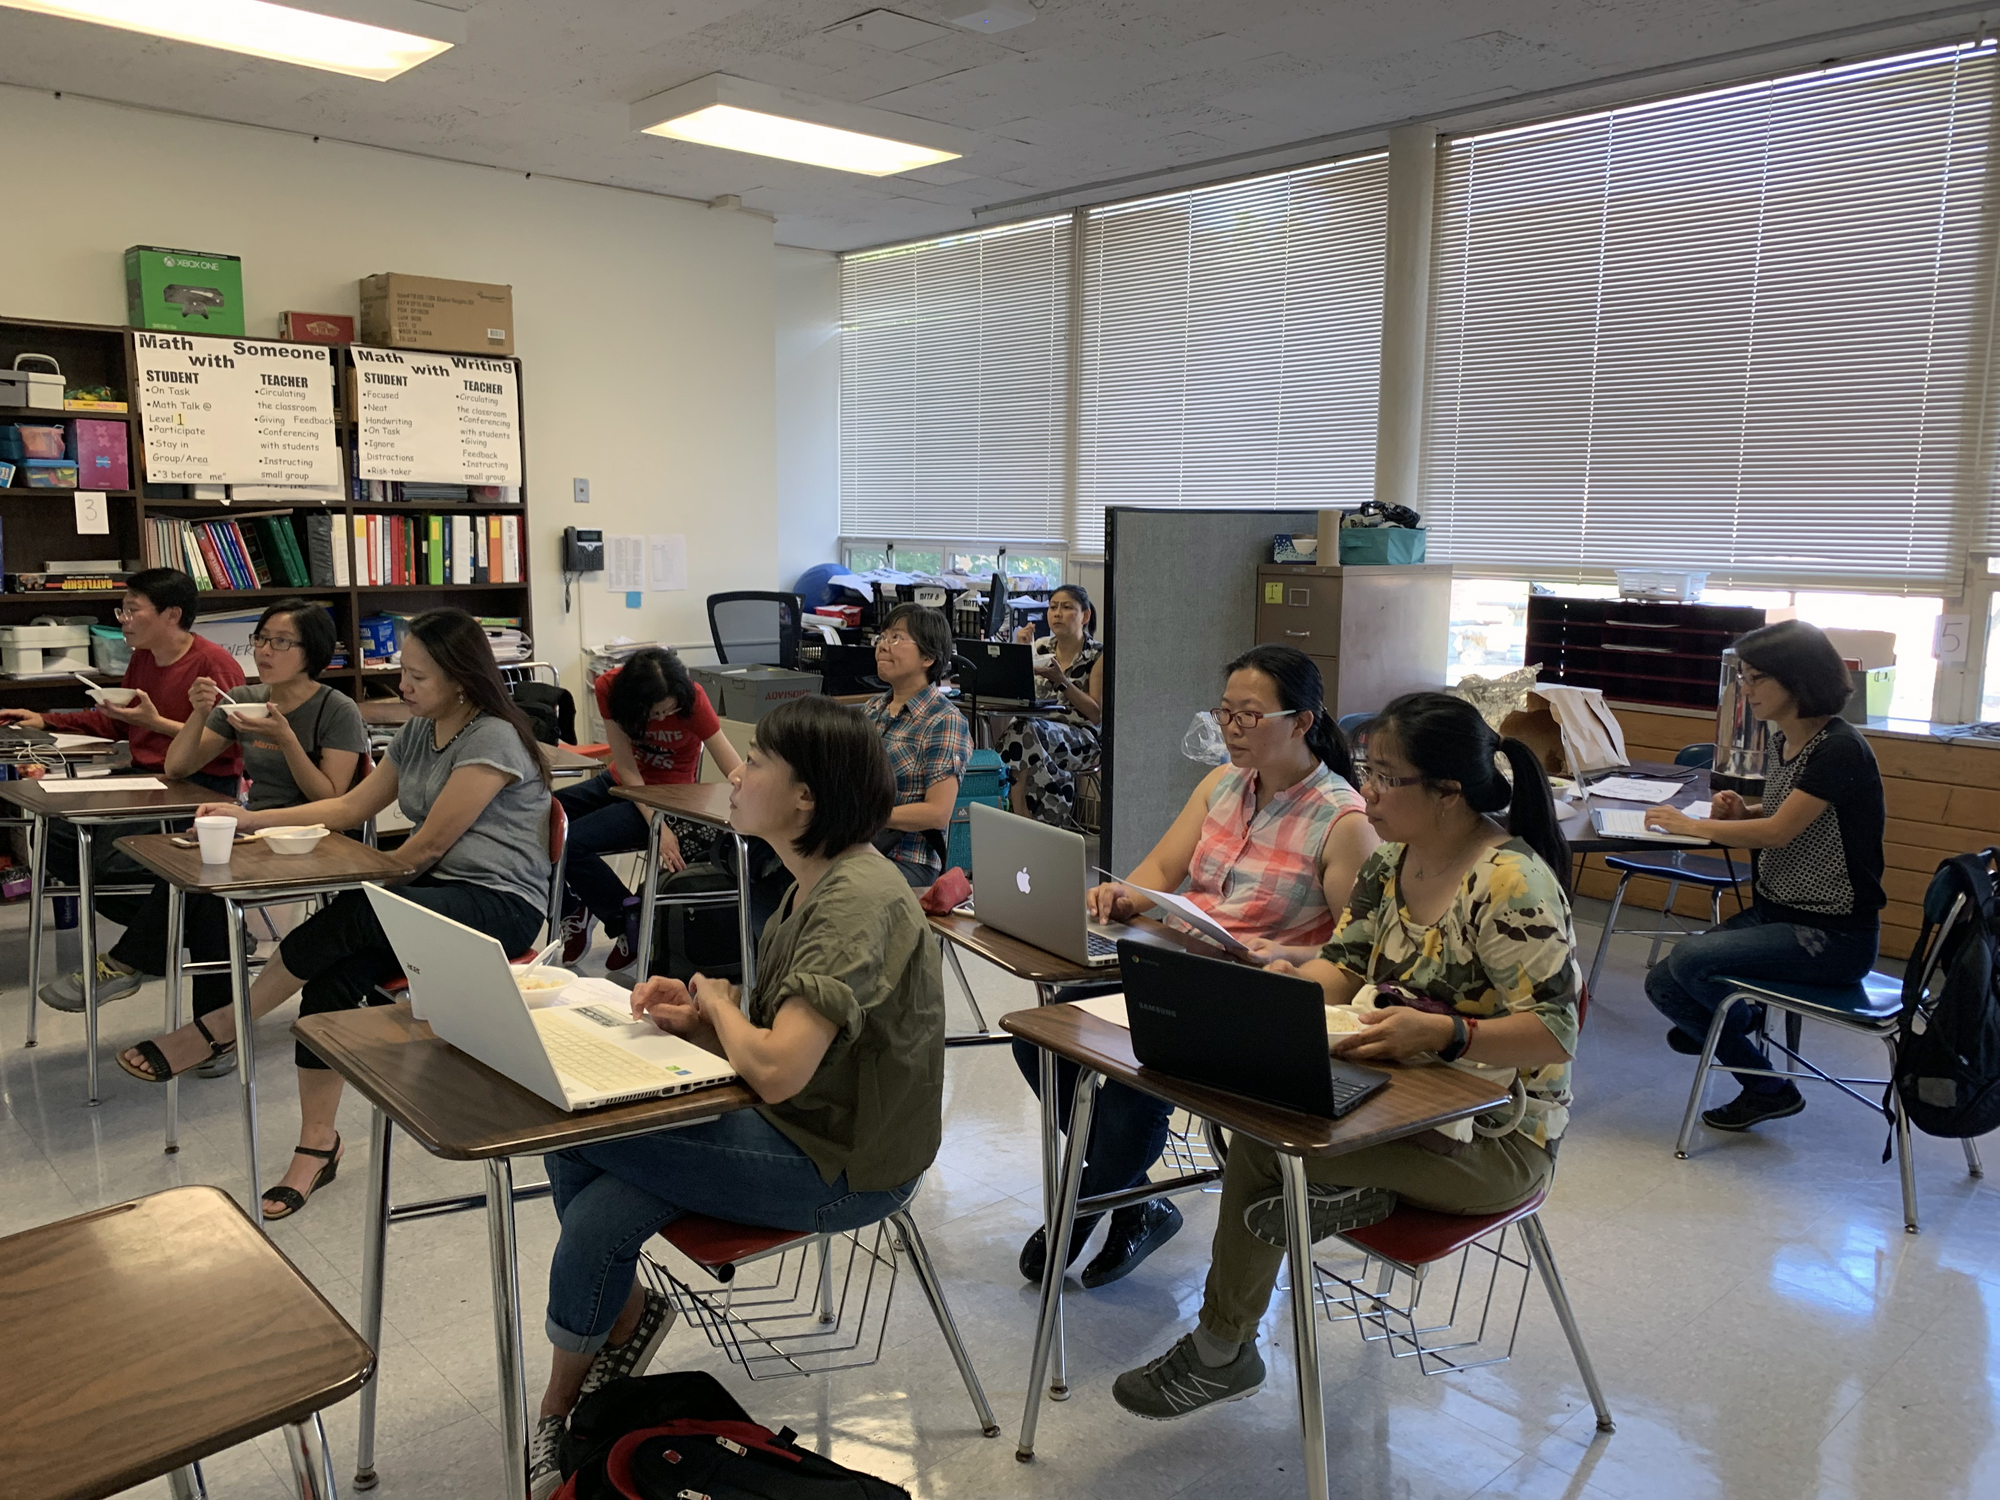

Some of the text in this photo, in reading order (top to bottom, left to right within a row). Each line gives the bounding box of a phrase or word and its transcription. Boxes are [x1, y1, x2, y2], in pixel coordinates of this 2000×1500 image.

[177, 259, 219, 271] XBOX ONE
[139, 335, 326, 368] Math with Someone
[358, 351, 513, 377] Math with Writing
[146, 370, 199, 384] STUDENT
[260, 374, 308, 388] TEACHER
[364, 372, 408, 386] STUDENT
[151, 387, 190, 396] On Task
[463, 380, 502, 395] TEACHER
[260, 388, 306, 400] Circulating
[367, 390, 399, 399] Focused
[460, 393, 498, 406] Circulating
[152, 401, 176, 409] Math
[180, 402, 200, 410] Talk
[275, 402, 317, 412] classroom
[472, 407, 507, 418] classroom
[150, 413, 184, 425] Level 1
[259, 416, 334, 426] Giving Feedback
[366, 417, 412, 428] Handwriting
[463, 416, 510, 428] Conferencing
[154, 426, 205, 436] Participate
[263, 428, 319, 440] Conferencing
[478, 430, 510, 439] students
[155, 441, 177, 450] Stay
[261, 442, 319, 451] with students
[369, 440, 395, 449] Ignore
[465, 438, 487, 448] Giving
[153, 454, 208, 464] Group/Area
[367, 452, 414, 462] Distractions
[463, 450, 498, 459] Feedback
[264, 458, 313, 468] Instructing
[467, 461, 508, 470] Instructing
[171, 471, 202, 479] before
[210, 472, 226, 481] me"
[261, 471, 309, 481] small group
[372, 467, 412, 476] Risk-taker
[84, 499, 98, 521] 3
[62, 579, 113, 590] BATTLESHIP
[1268, 584, 1275, 600] 1
[1942, 622, 1963, 653] 5
[406, 962, 420, 975] acer
[1139, 1002, 1176, 1017] SAMSUNG
